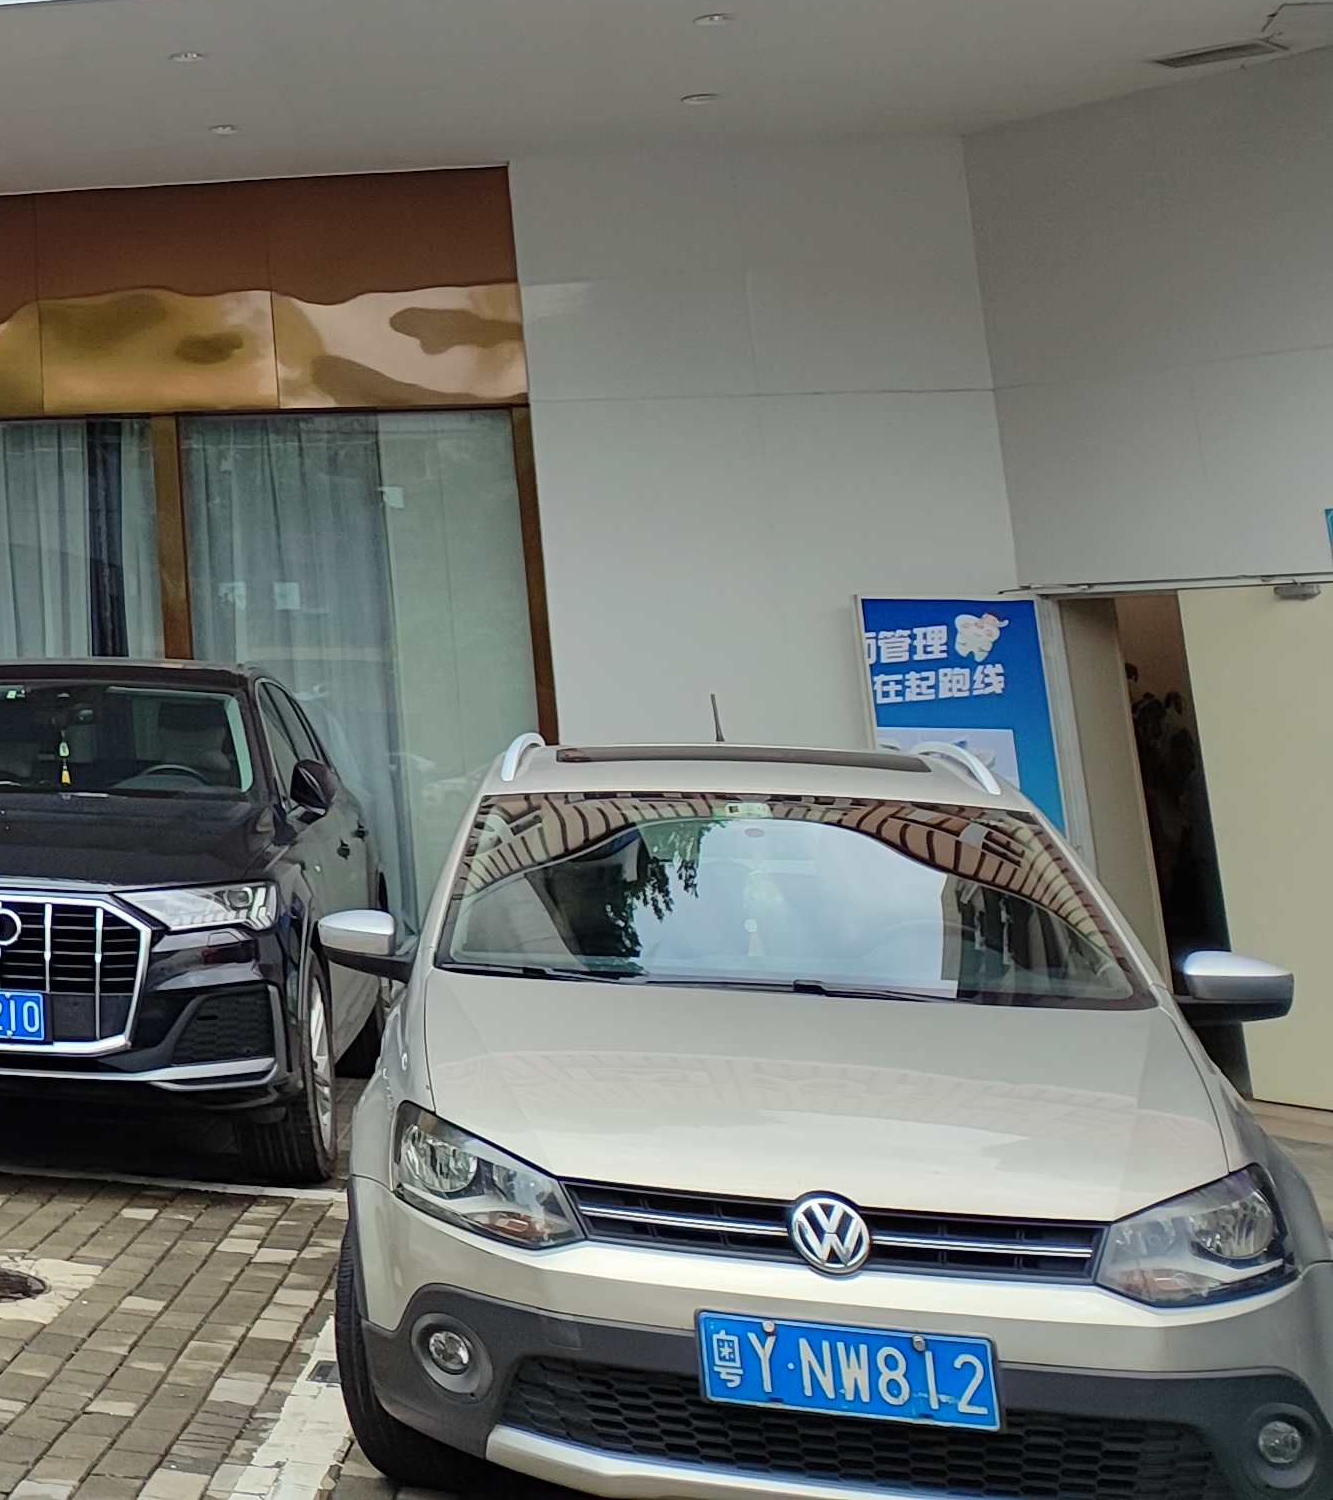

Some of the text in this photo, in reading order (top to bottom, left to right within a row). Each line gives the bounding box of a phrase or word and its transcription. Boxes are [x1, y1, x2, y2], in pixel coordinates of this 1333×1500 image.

[873, 663, 1005, 705] 在起跑线
[711, 1329, 989, 1416] 粤Y·NW812
